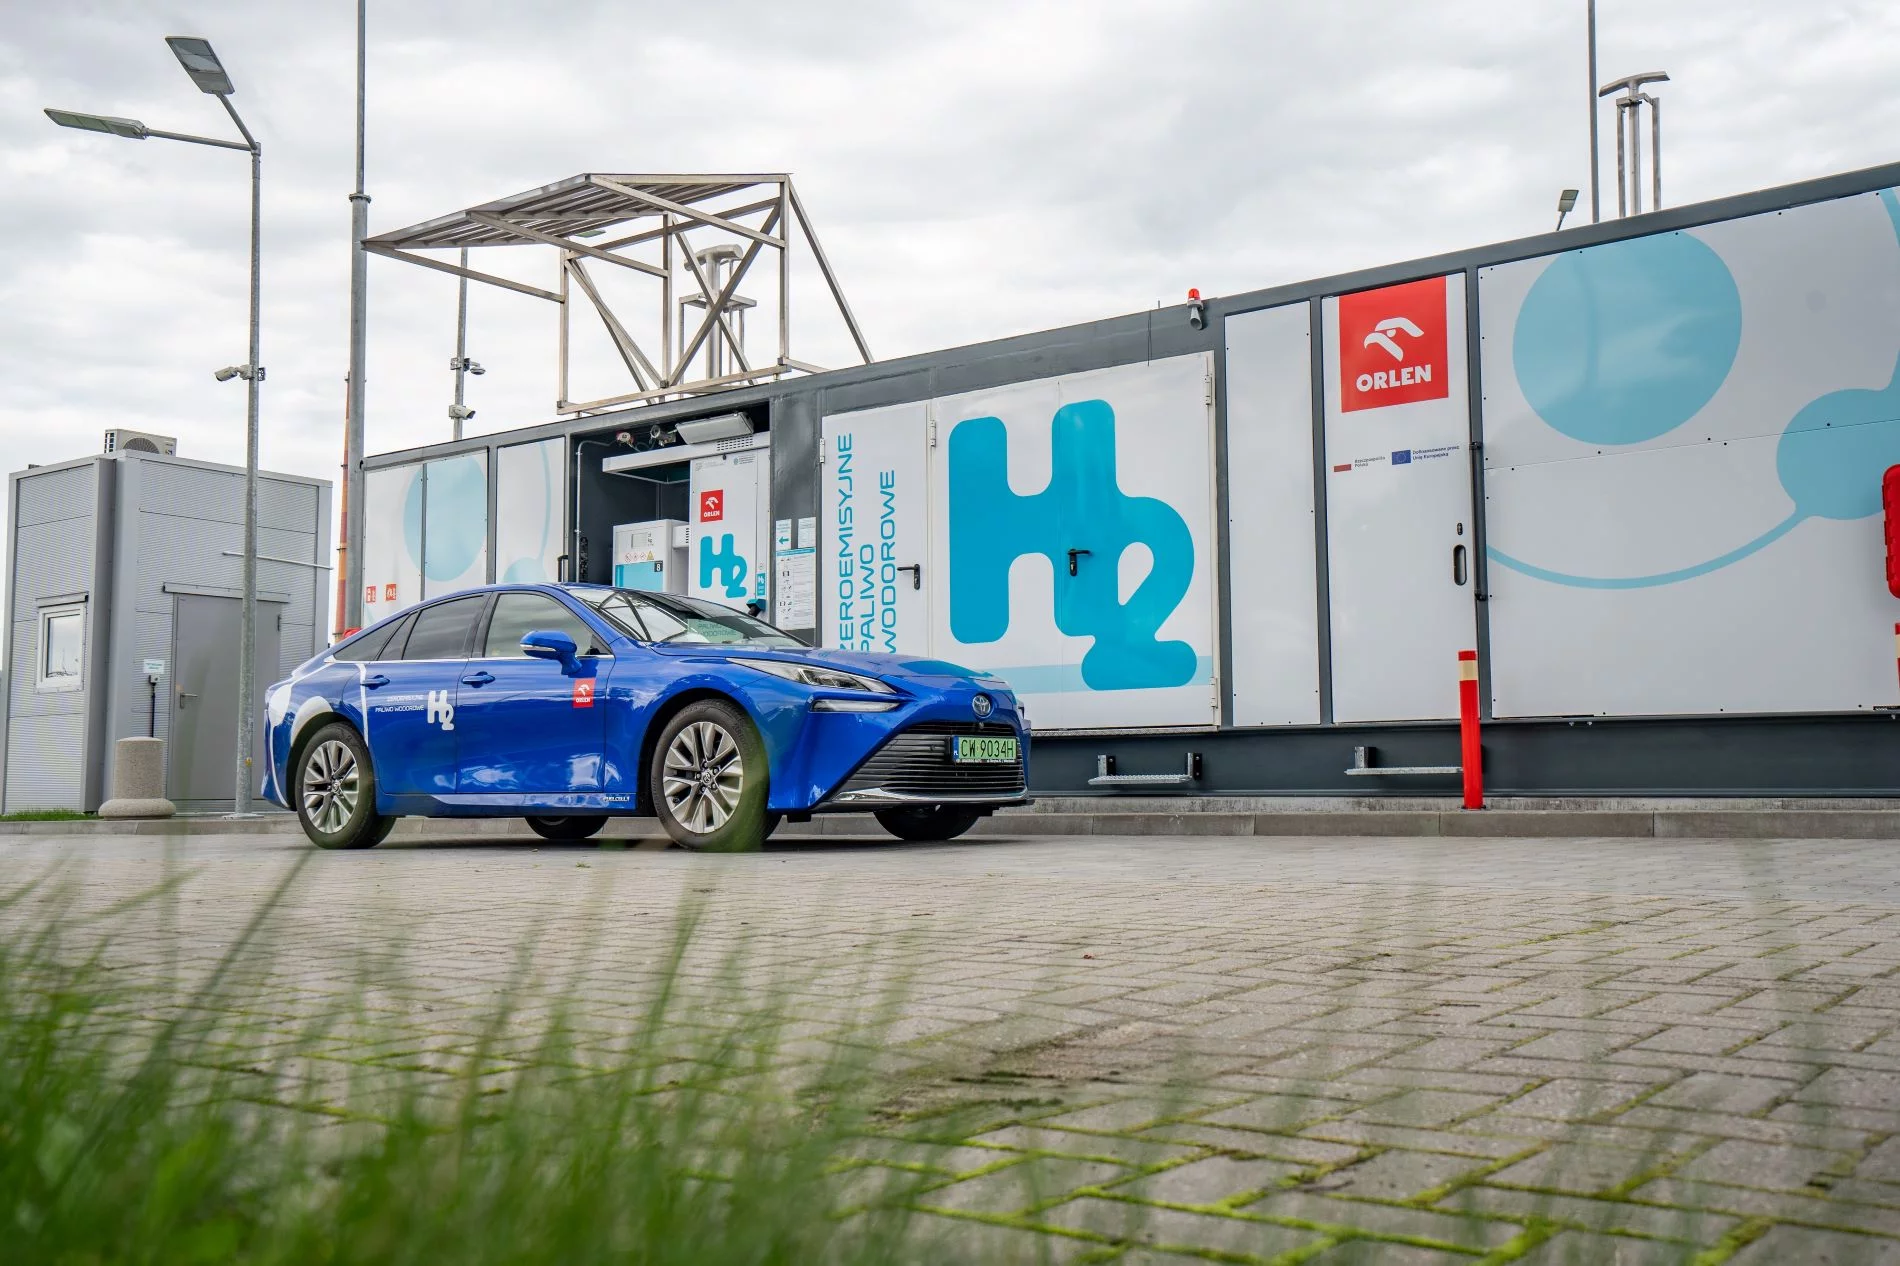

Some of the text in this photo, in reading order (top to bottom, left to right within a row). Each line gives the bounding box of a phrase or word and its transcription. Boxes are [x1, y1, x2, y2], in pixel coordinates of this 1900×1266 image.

[1356, 364, 1432, 392] ORLEN
[656, 563, 661, 572] 8
[700, 533, 748, 599] H2
[880, 470, 896, 653] WODOROWE
[948, 399, 1198, 690] H2
[860, 543, 875, 652] PALIWO
[428, 690, 454, 730] H2
[961, 739, 1014, 758] CW 9034H
